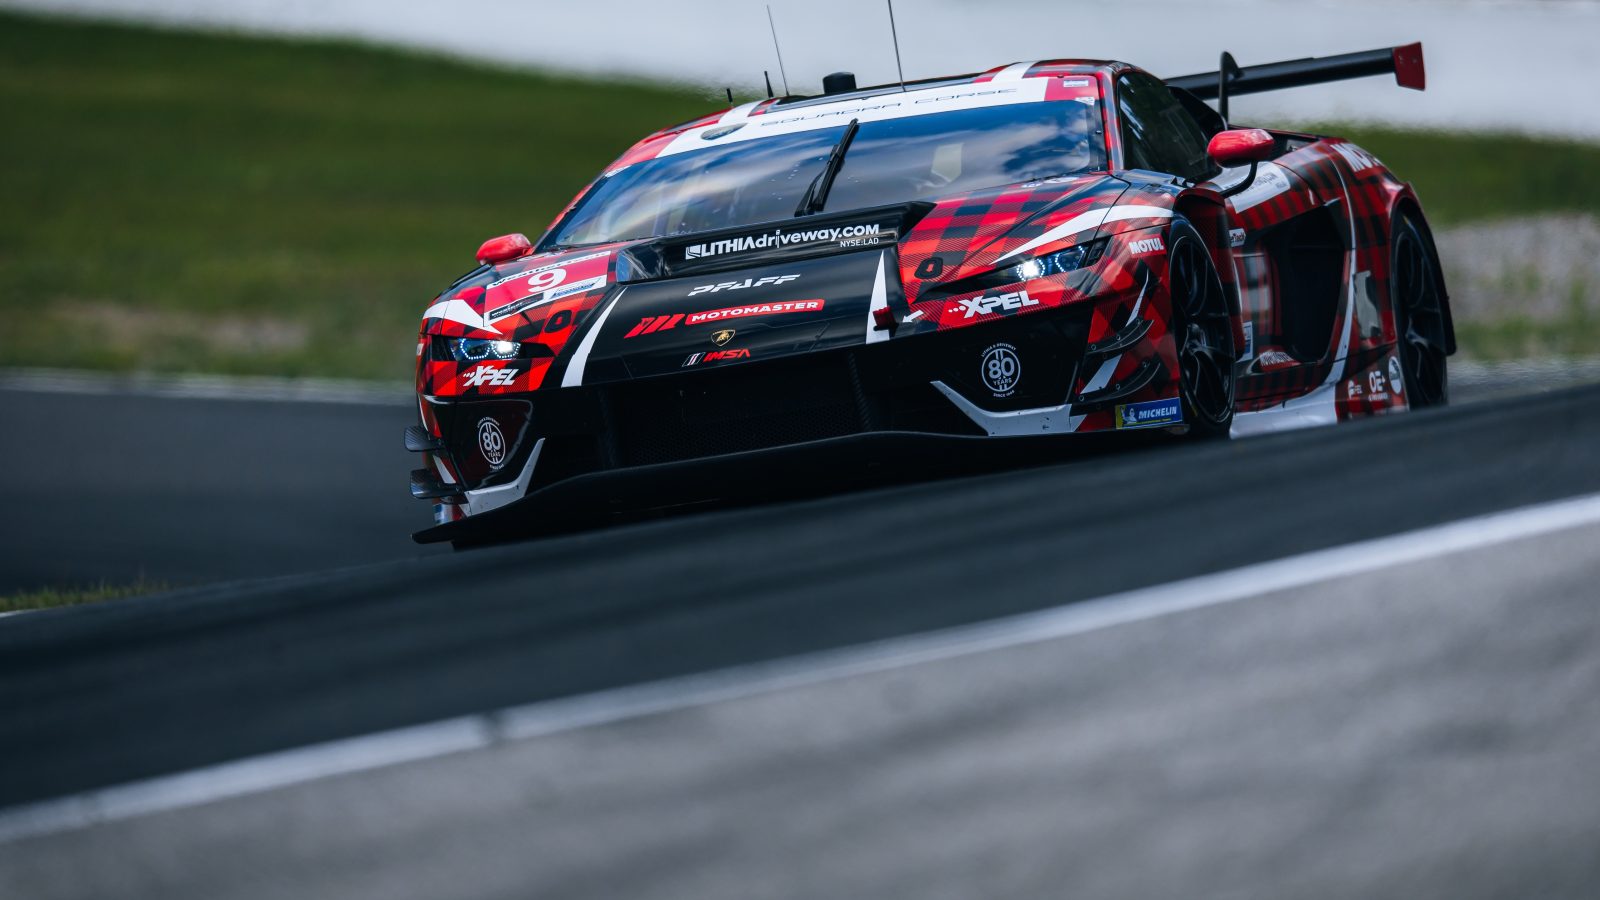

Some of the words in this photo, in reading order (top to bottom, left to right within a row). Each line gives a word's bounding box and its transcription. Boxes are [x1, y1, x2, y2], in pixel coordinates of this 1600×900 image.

[760, 102, 901, 128] SQUADRA
[914, 88, 1017, 104] CORSE
[1128, 238, 1165, 255] MOTUL
[527, 268, 567, 293] 9
[687, 274, 801, 297] PFAFF
[690, 300, 819, 323] MOTOMASTER
[959, 290, 1039, 318] XPEL
[703, 348, 751, 363] IMSA
[462, 366, 520, 387] XPEL
[988, 357, 1015, 379] 80
[993, 377, 1012, 386] YEARS
[1138, 406, 1177, 420] MICHELIN
[482, 431, 501, 451] 80
